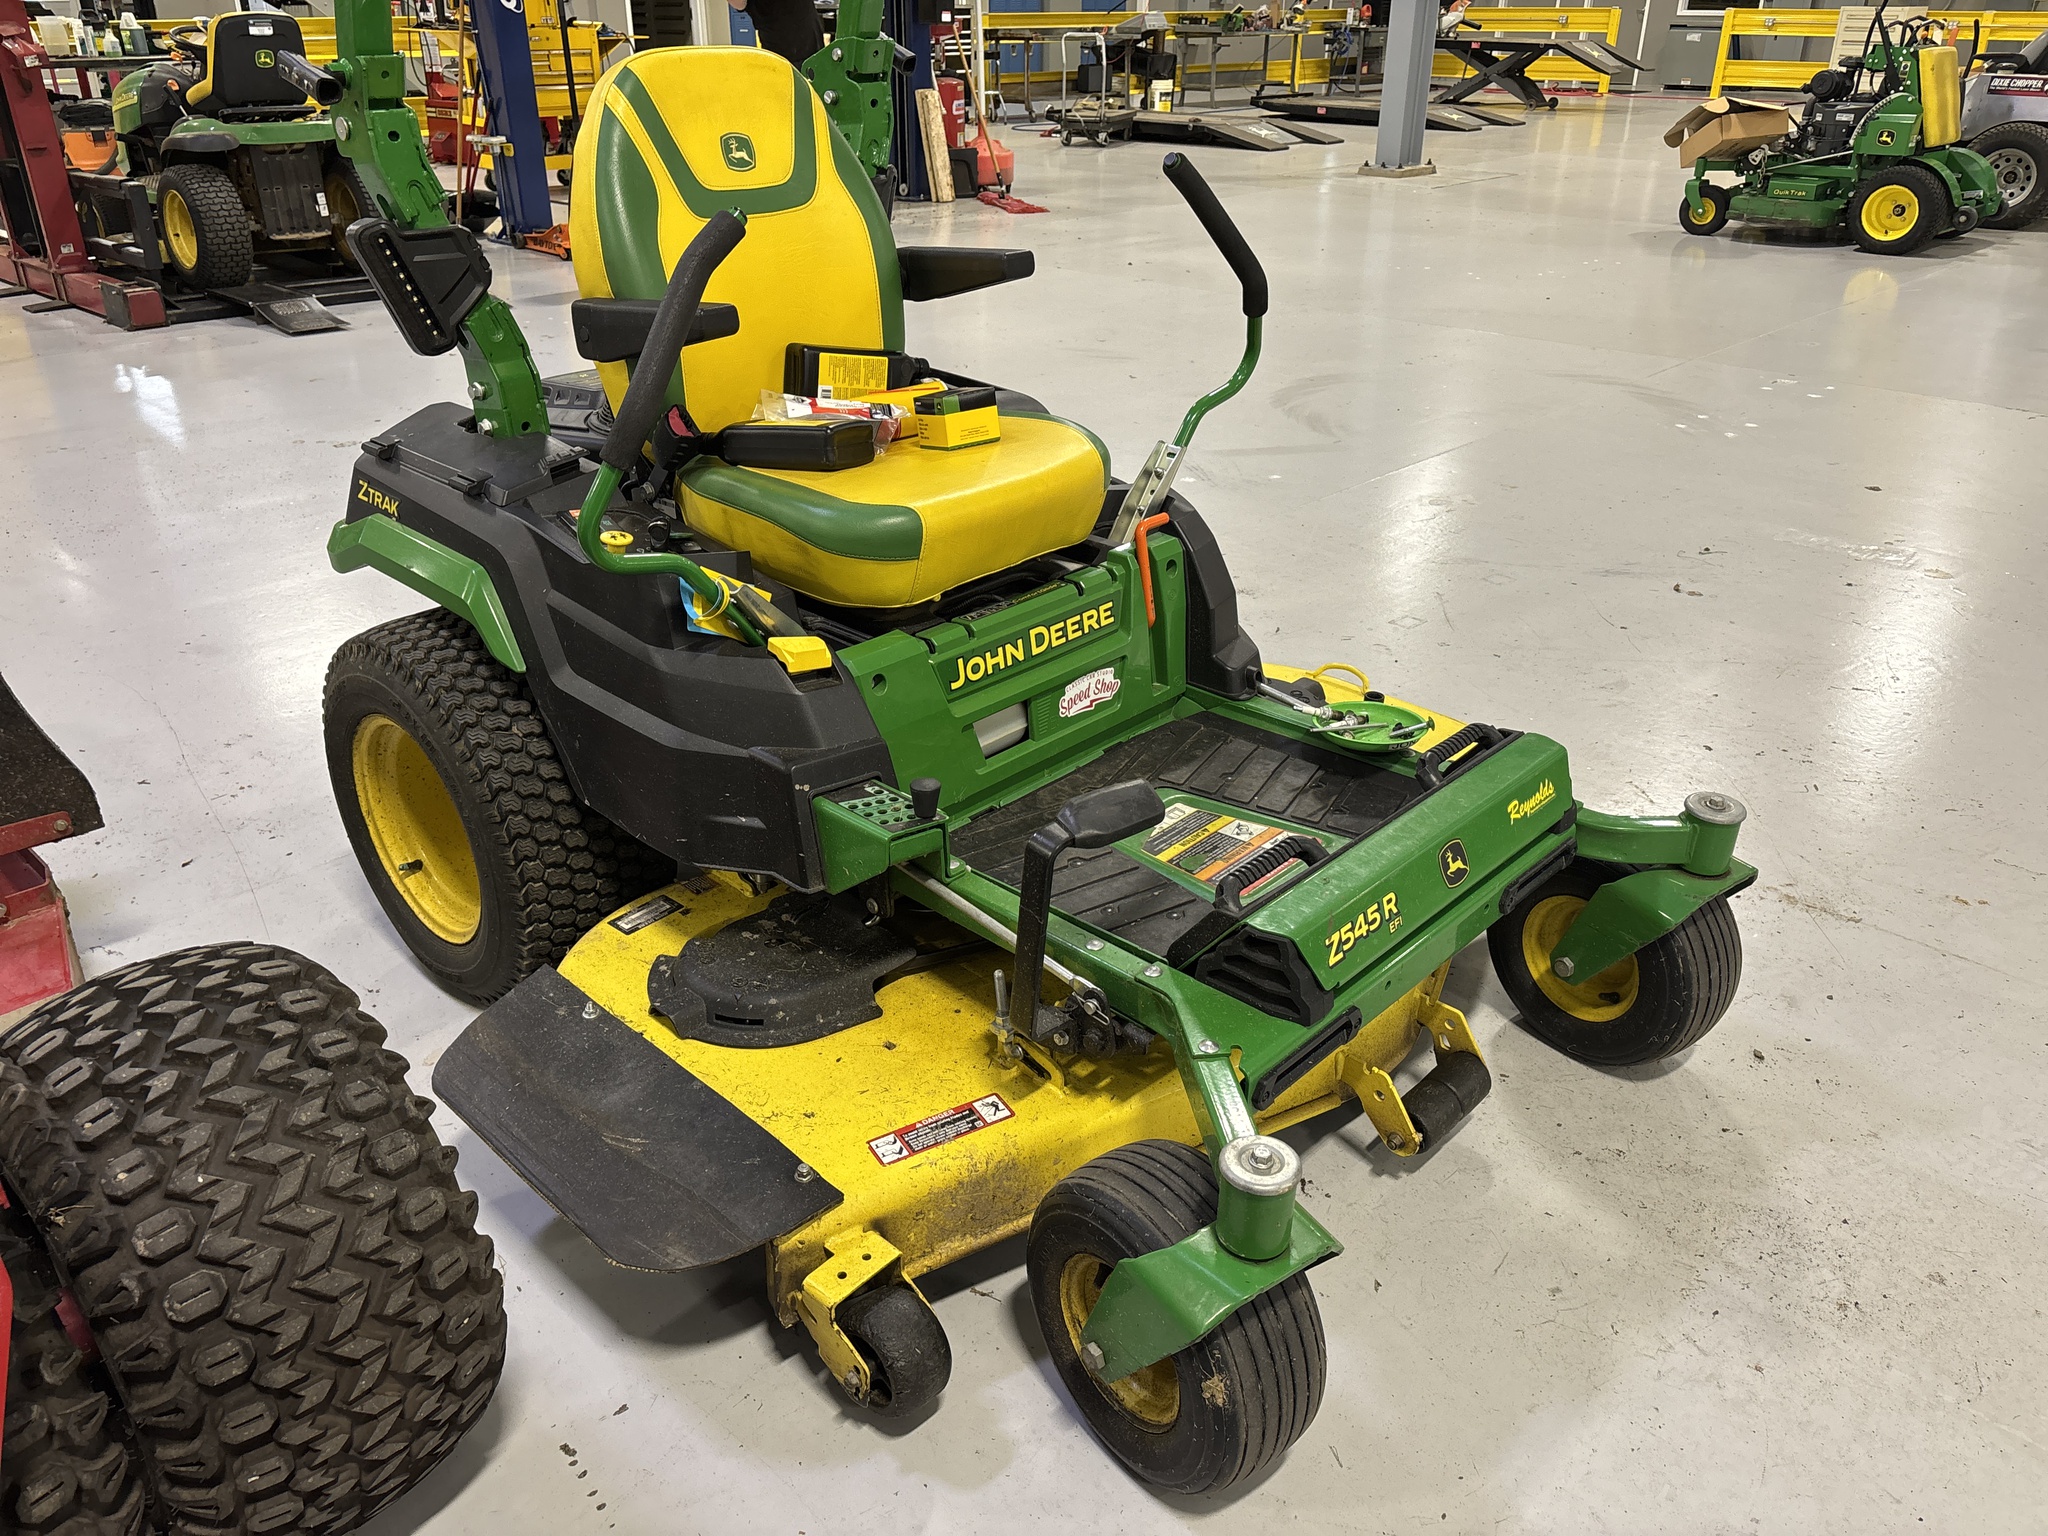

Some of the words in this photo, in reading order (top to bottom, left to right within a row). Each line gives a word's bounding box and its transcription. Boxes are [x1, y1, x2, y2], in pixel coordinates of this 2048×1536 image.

[1990, 78, 2010, 86] DIXIE
[2010, 79, 2043, 88] CHOPPER
[950, 638, 1025, 690] JOHN
[1029, 601, 1115, 656] DEERE
[1066, 677, 1085, 692] CLASSIC
[1086, 672, 1096, 681] CAR
[1096, 669, 1113, 678] STUDIO
[1060, 681, 1091, 716] Speed
[1093, 677, 1119, 698] Shop
[1507, 778, 1555, 826] Reynolds
[1389, 915, 1403, 934] EFI
[921, 1110, 955, 1125] DANGER
